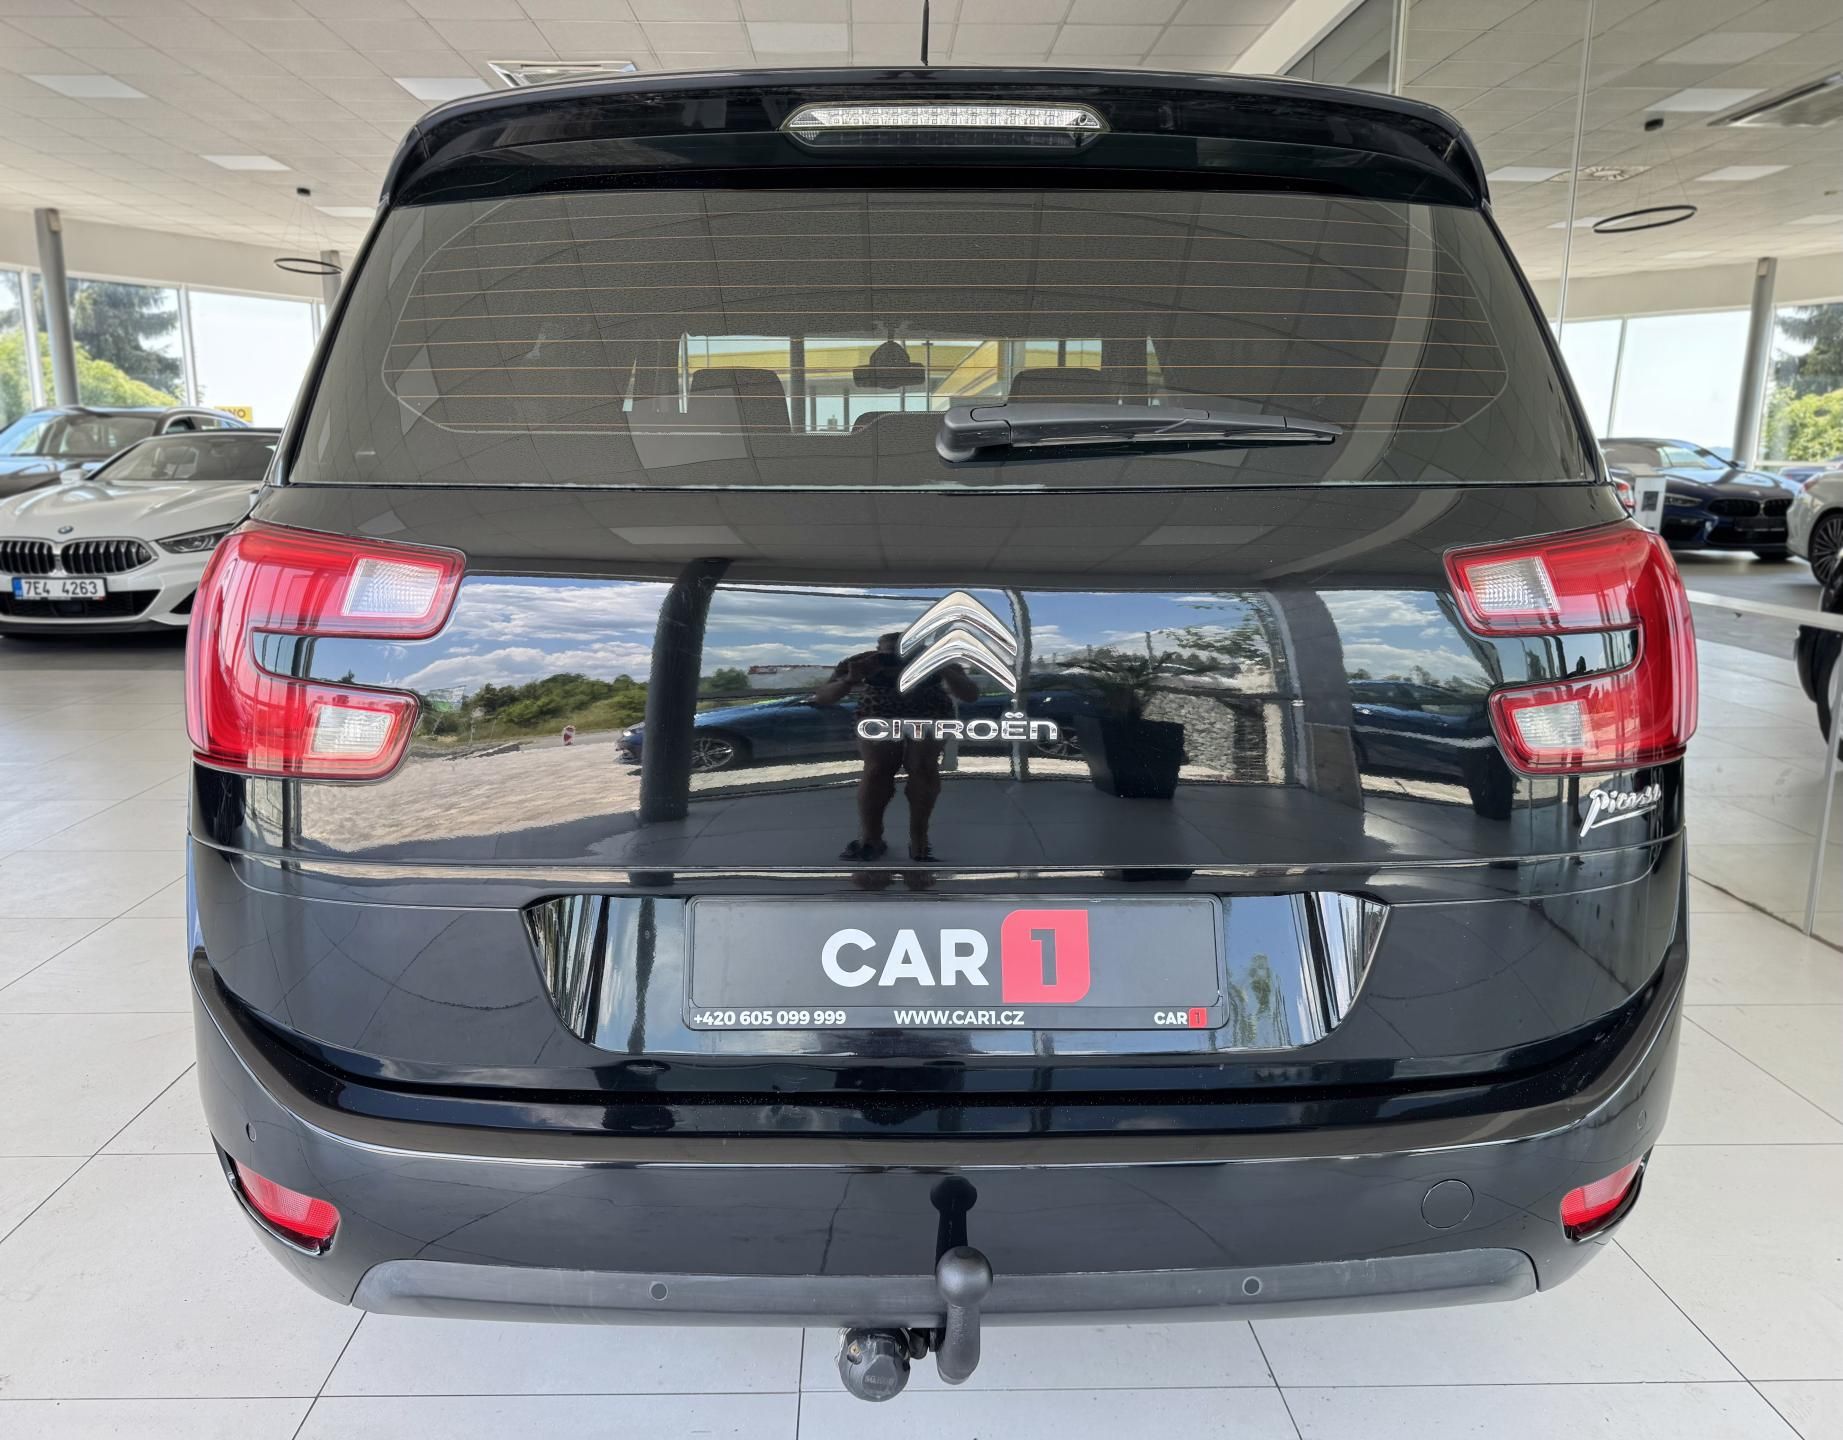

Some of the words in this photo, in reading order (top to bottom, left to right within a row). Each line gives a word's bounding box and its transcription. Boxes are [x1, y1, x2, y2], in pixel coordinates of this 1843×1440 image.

[24, 581, 50, 595] 7E4
[62, 581, 98, 595] 4263
[694, 1011, 736, 1026] +420
[739, 1011, 773, 1025] 605
[776, 1010, 810, 1025] 099
[813, 1010, 847, 1025] 999
[893, 1010, 1025, 1025] WWW.CAR1.CZ
